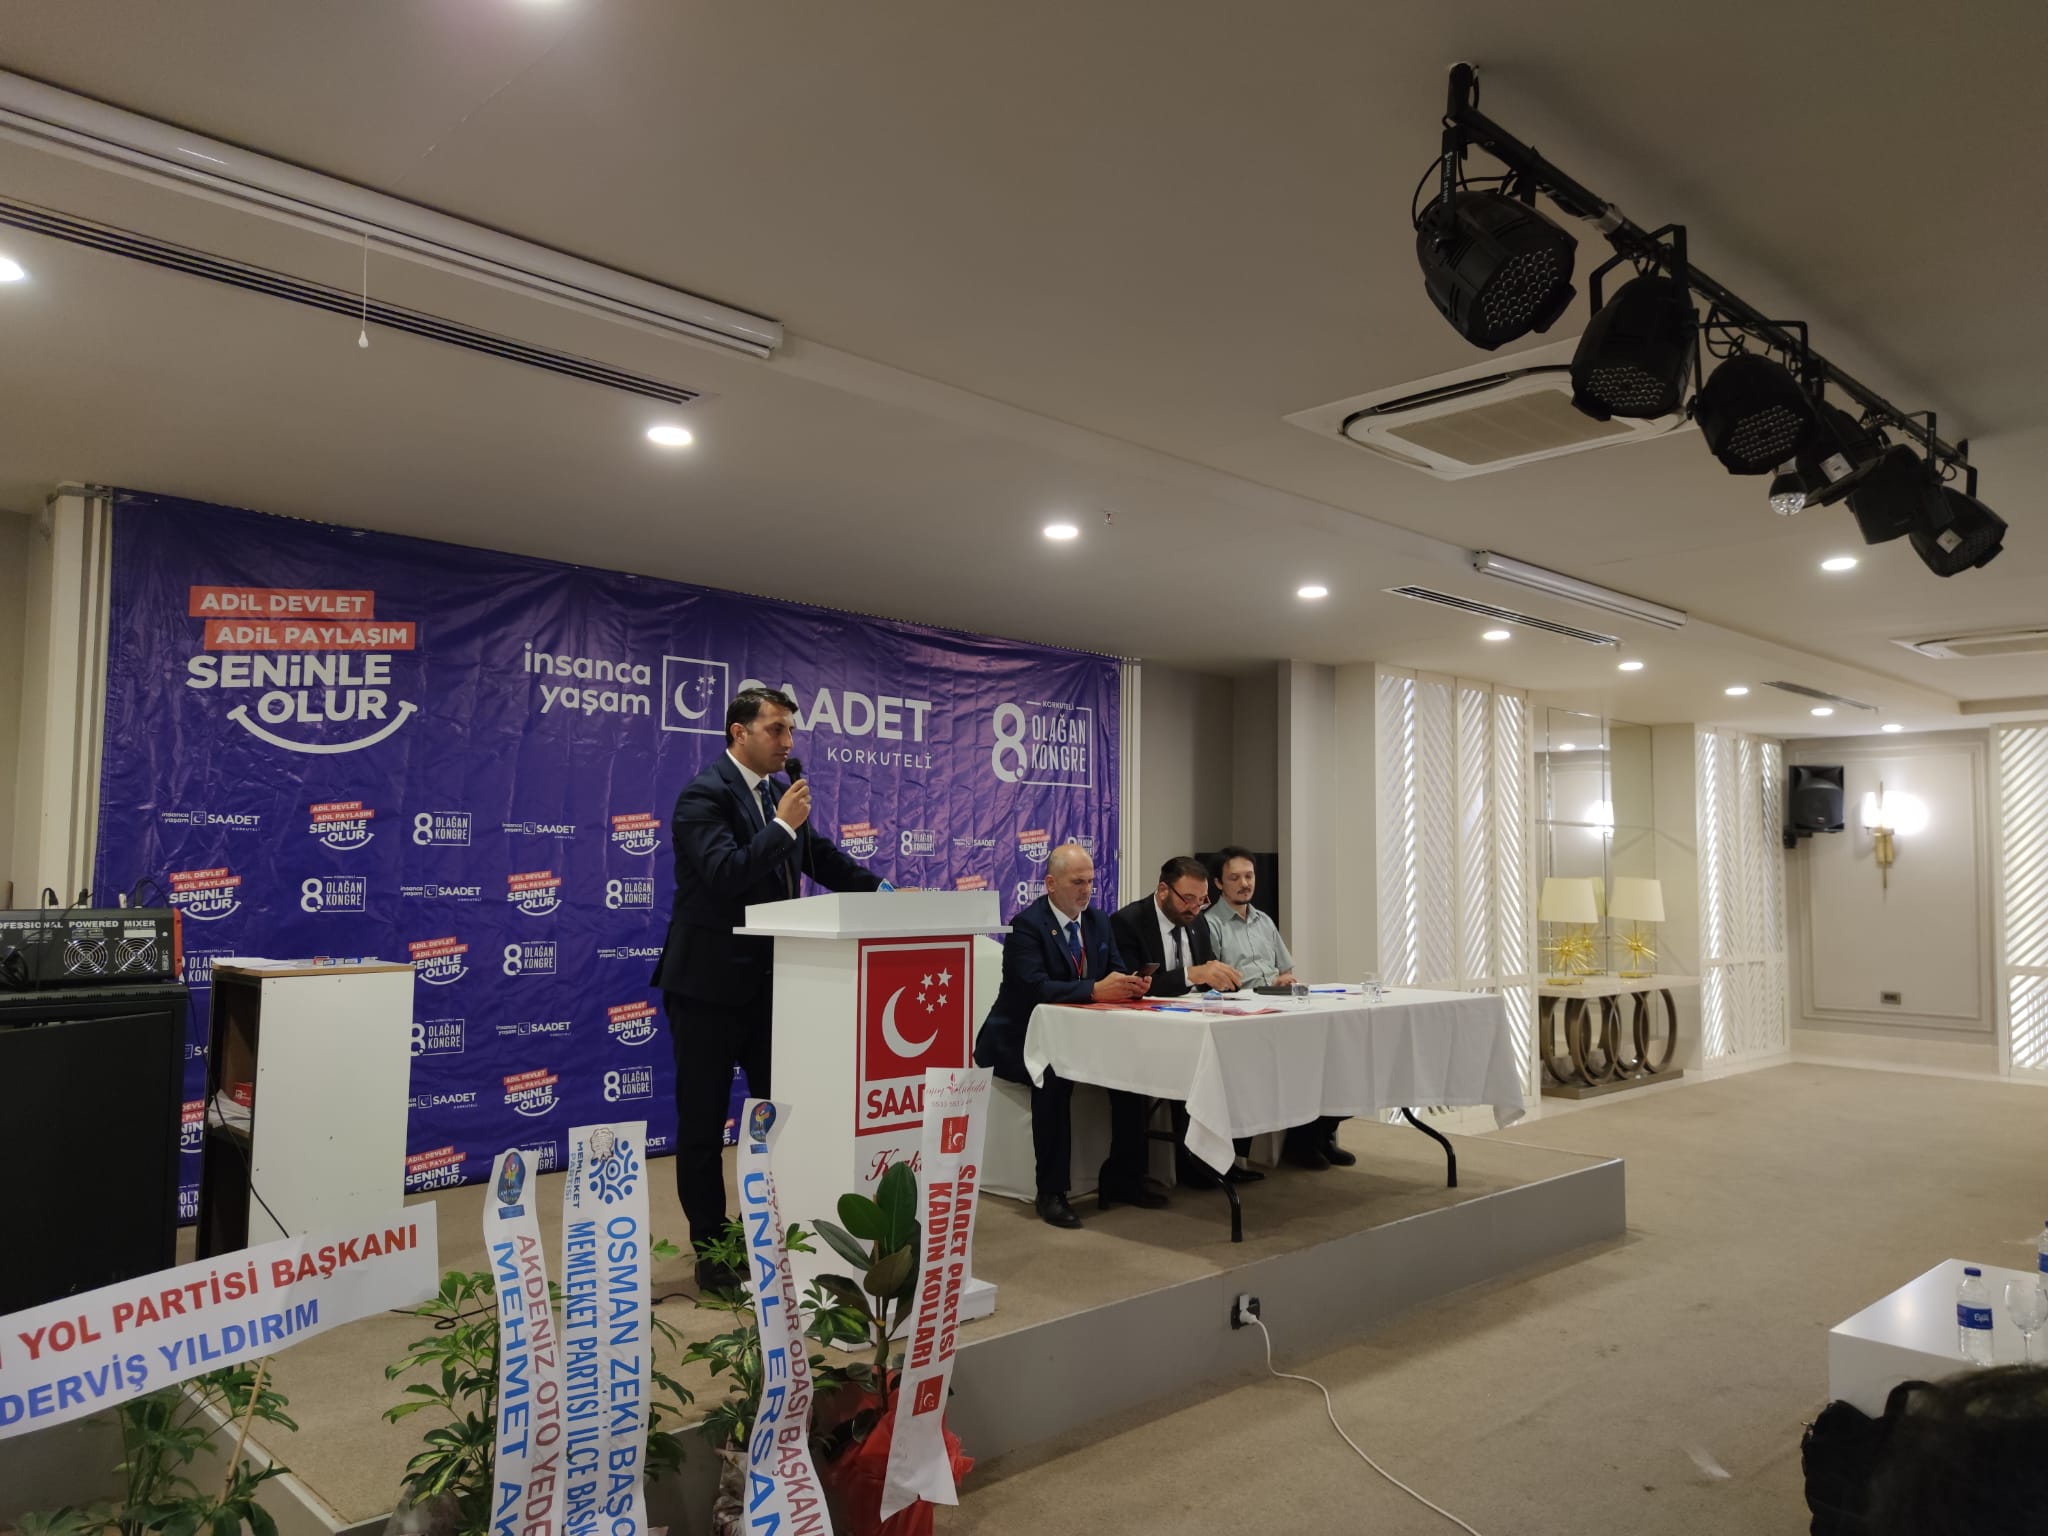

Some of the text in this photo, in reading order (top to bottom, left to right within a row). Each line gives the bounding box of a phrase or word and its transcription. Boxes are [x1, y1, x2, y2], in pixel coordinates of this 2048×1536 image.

[269, 594, 366, 613] DEVLET
[285, 627, 408, 647] PAYLAŞIM
[524, 642, 651, 686] insanca
[257, 689, 388, 724] OLUR
[539, 684, 650, 716] yaşam
[1032, 714, 1086, 745] OLAĞAN
[828, 747, 933, 769] KORKUTELİ
[1031, 744, 1086, 772] KONGRE
[207, 814, 260, 825] SAADET
[327, 830, 365, 842] OLUR
[435, 828, 468, 840] KONGRE
[536, 824, 576, 834] SAADET
[626, 838, 654, 848] OLUR
[851, 844, 874, 853] OLUR
[194, 870, 225, 878] DEVLET
[438, 886, 482, 896] SAADET
[190, 898, 232, 912] OLUR
[326, 894, 362, 906] KONGRE
[523, 897, 555, 909] OLUR
[69, 920, 119, 928] POWERED
[425, 964, 461, 978] OLUR
[524, 957, 553, 969] KONGRE
[531, 1021, 571, 1032] SAADET
[622, 1026, 651, 1040] OLUR
[428, 1036, 461, 1049] KONGRE
[432, 1092, 477, 1105] SAADET
[520, 1095, 552, 1110] OLUR
[425, 1148, 451, 1159] DEVLET
[423, 1174, 459, 1190] OLUR
[572, 1141, 584, 1209] MEMLEKET
[743, 1172, 780, 1328] ÜNAL
[938, 1164, 977, 1363] SAADET PARTİSİ
[566, 1221, 598, 1330] MEMLEKET
[606, 1216, 640, 1346] OSMAN
[910, 1182, 953, 1369] KADIN KOLLARI
[18, 1224, 418, 1361] YOL PARTİSİ BAŞKANI
[516, 1234, 557, 1375] AKDENİZ
[493, 1241, 530, 1459] MEHMET
[0, 1298, 320, 1427] DERVİŞ YILDIRIM
[783, 1339, 810, 1420] ODASI
[610, 1355, 645, 1437] ZEKİ
[535, 1380, 561, 1446] OTO
